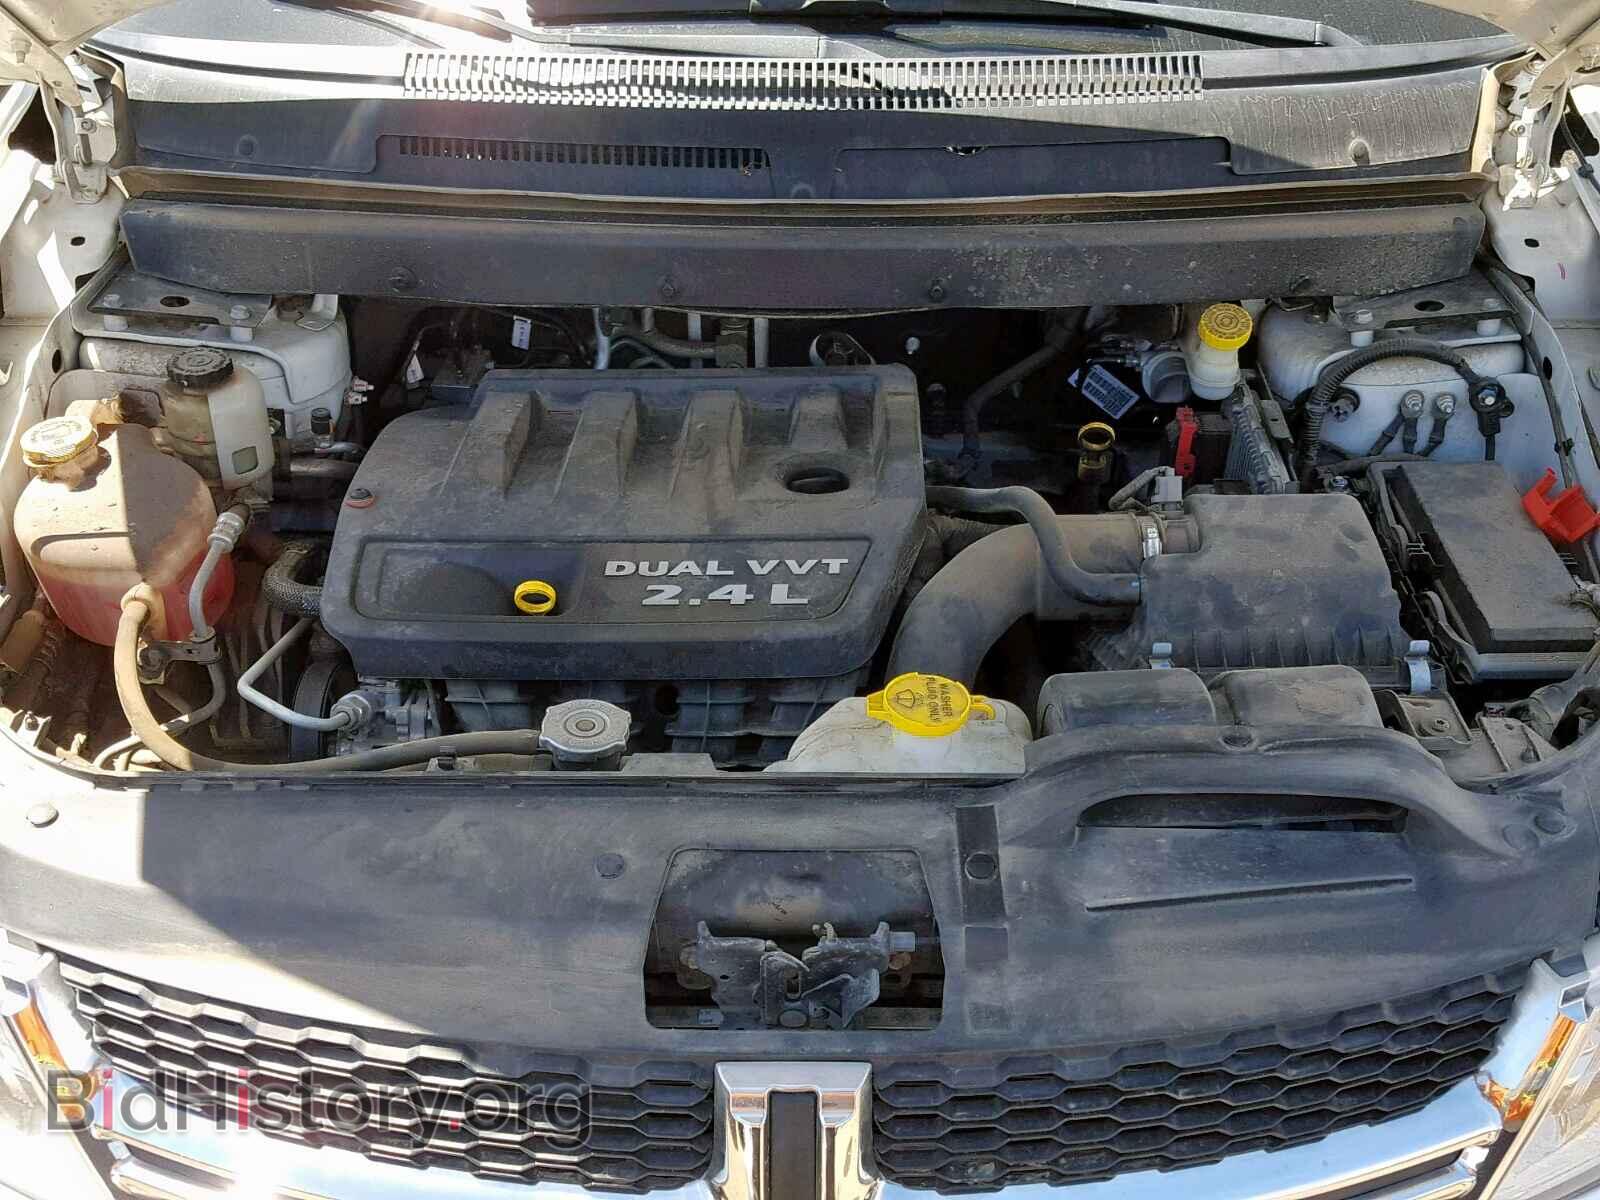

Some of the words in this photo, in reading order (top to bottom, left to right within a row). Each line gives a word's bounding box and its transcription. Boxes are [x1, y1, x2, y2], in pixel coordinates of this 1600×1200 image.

[604, 560, 735, 577] DUAL
[747, 558, 849, 575] VVT
[642, 583, 754, 606] 2.4
[770, 583, 809, 606] L
[926, 677, 937, 700] FLUID
[939, 683, 953, 717] WASHER
[928, 701, 941, 722] ONLY
